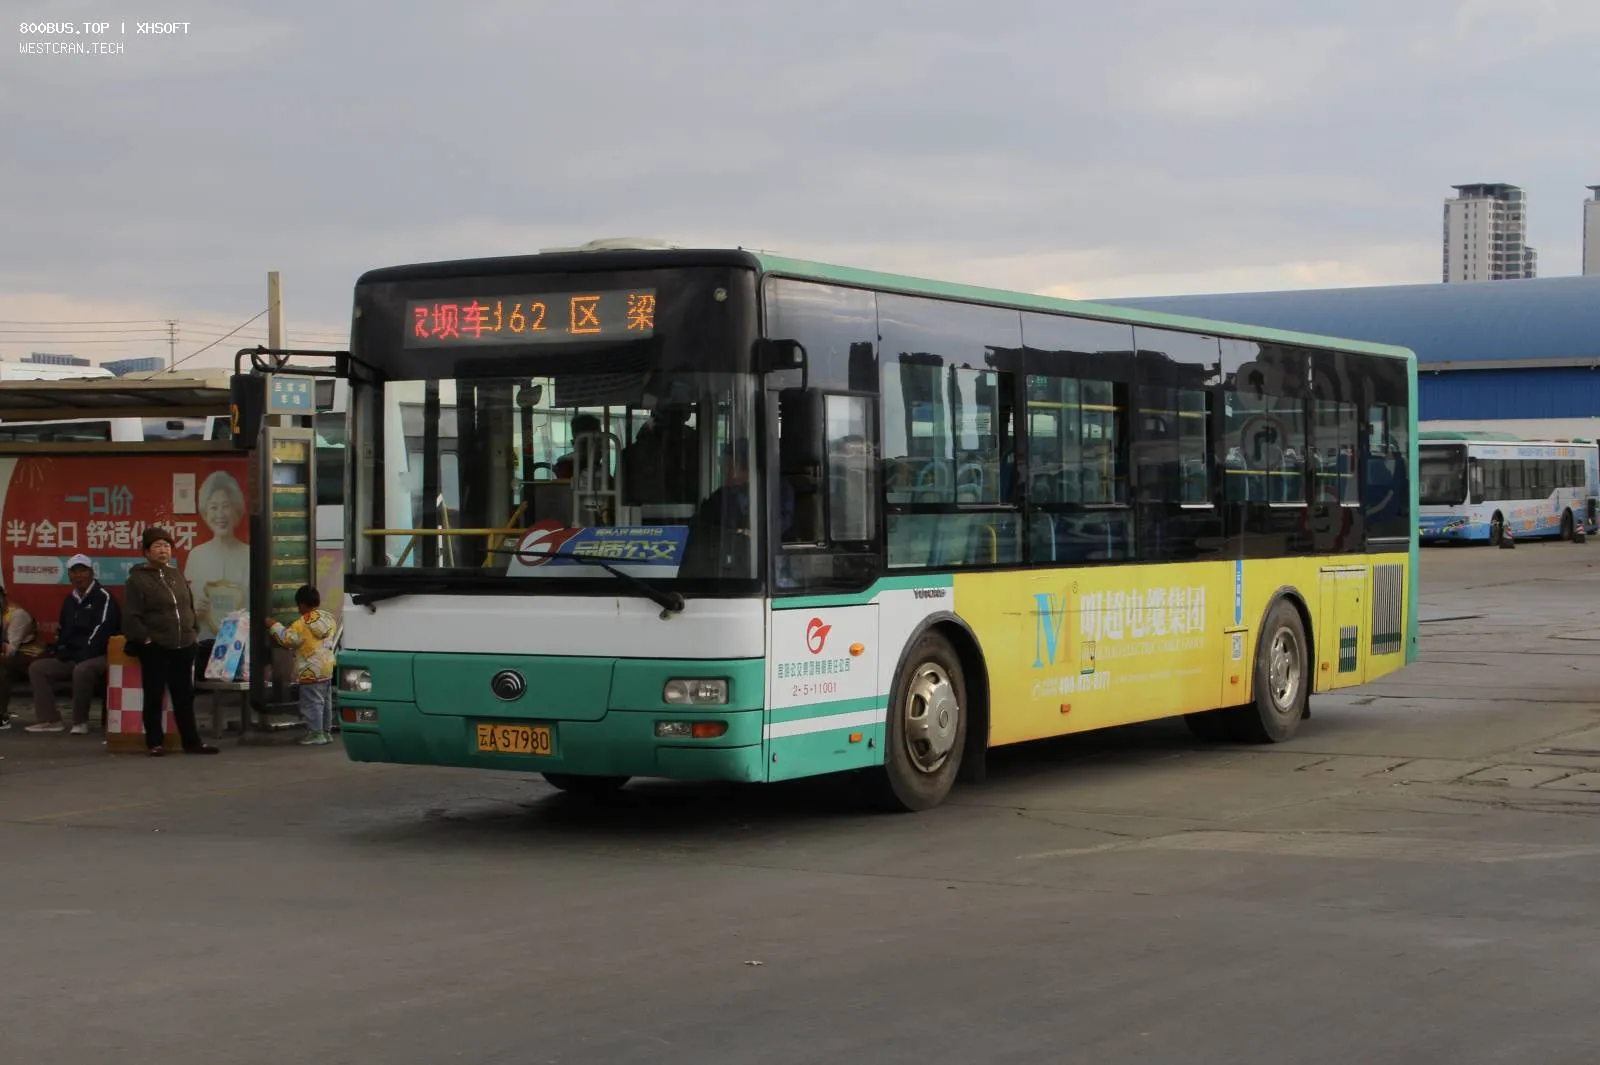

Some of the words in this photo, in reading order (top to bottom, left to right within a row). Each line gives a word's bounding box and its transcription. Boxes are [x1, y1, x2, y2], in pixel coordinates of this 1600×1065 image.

[568, 295, 601, 334] 区
[64, 485, 134, 516] 一口价
[6, 519, 79, 549] 半/全口
